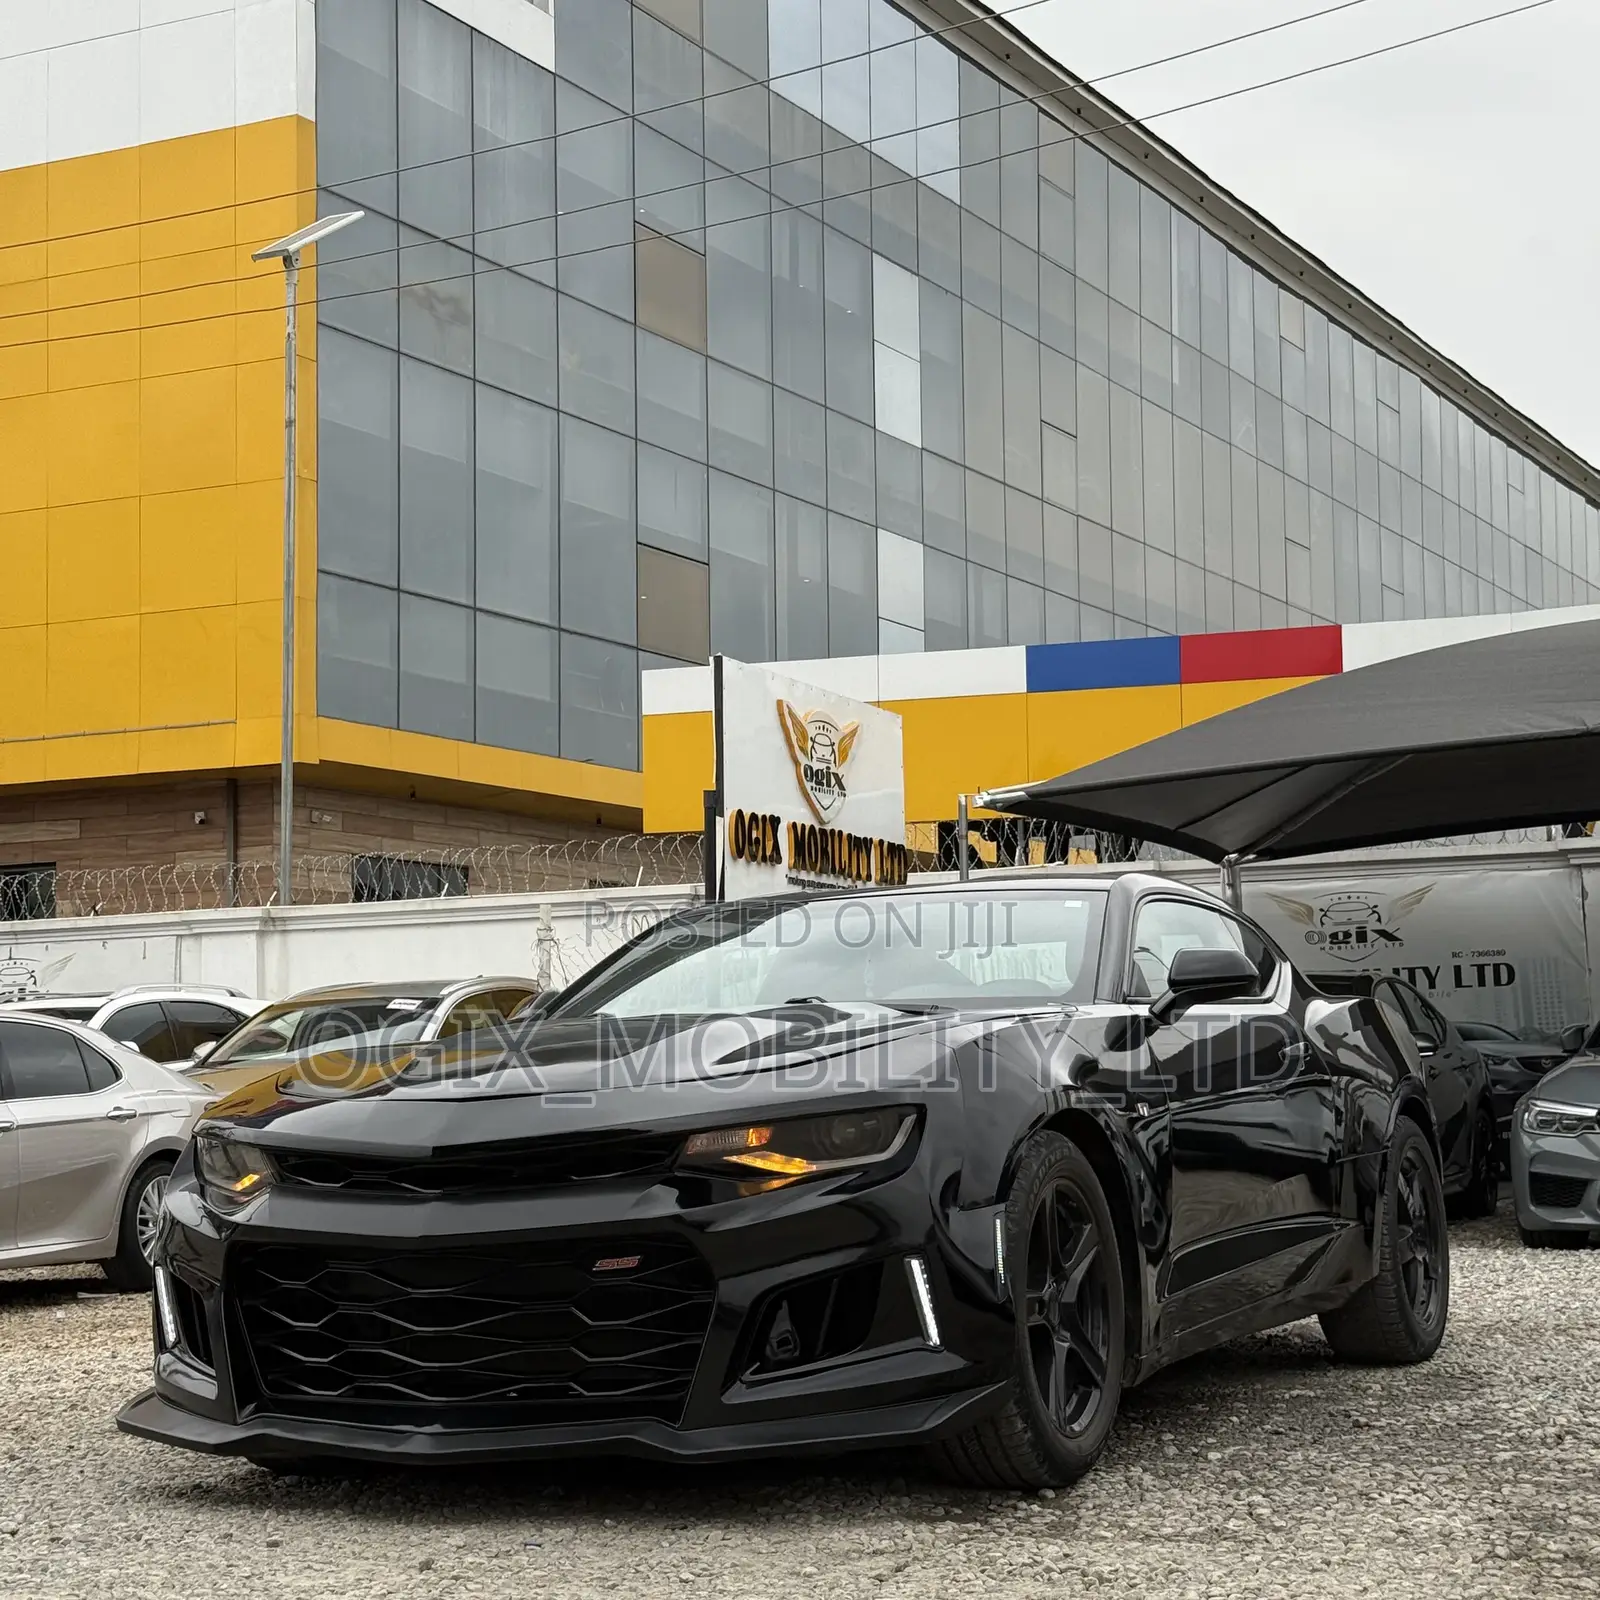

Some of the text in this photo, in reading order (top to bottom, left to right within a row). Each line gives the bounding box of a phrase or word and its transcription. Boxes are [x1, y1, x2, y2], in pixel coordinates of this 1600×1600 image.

[728, 808, 907, 885] OGIX MOBILITY LTD
[1320, 943, 1375, 951] MOBILITY
[1451, 951, 1463, 959] RC
[1453, 962, 1516, 988] LTD
